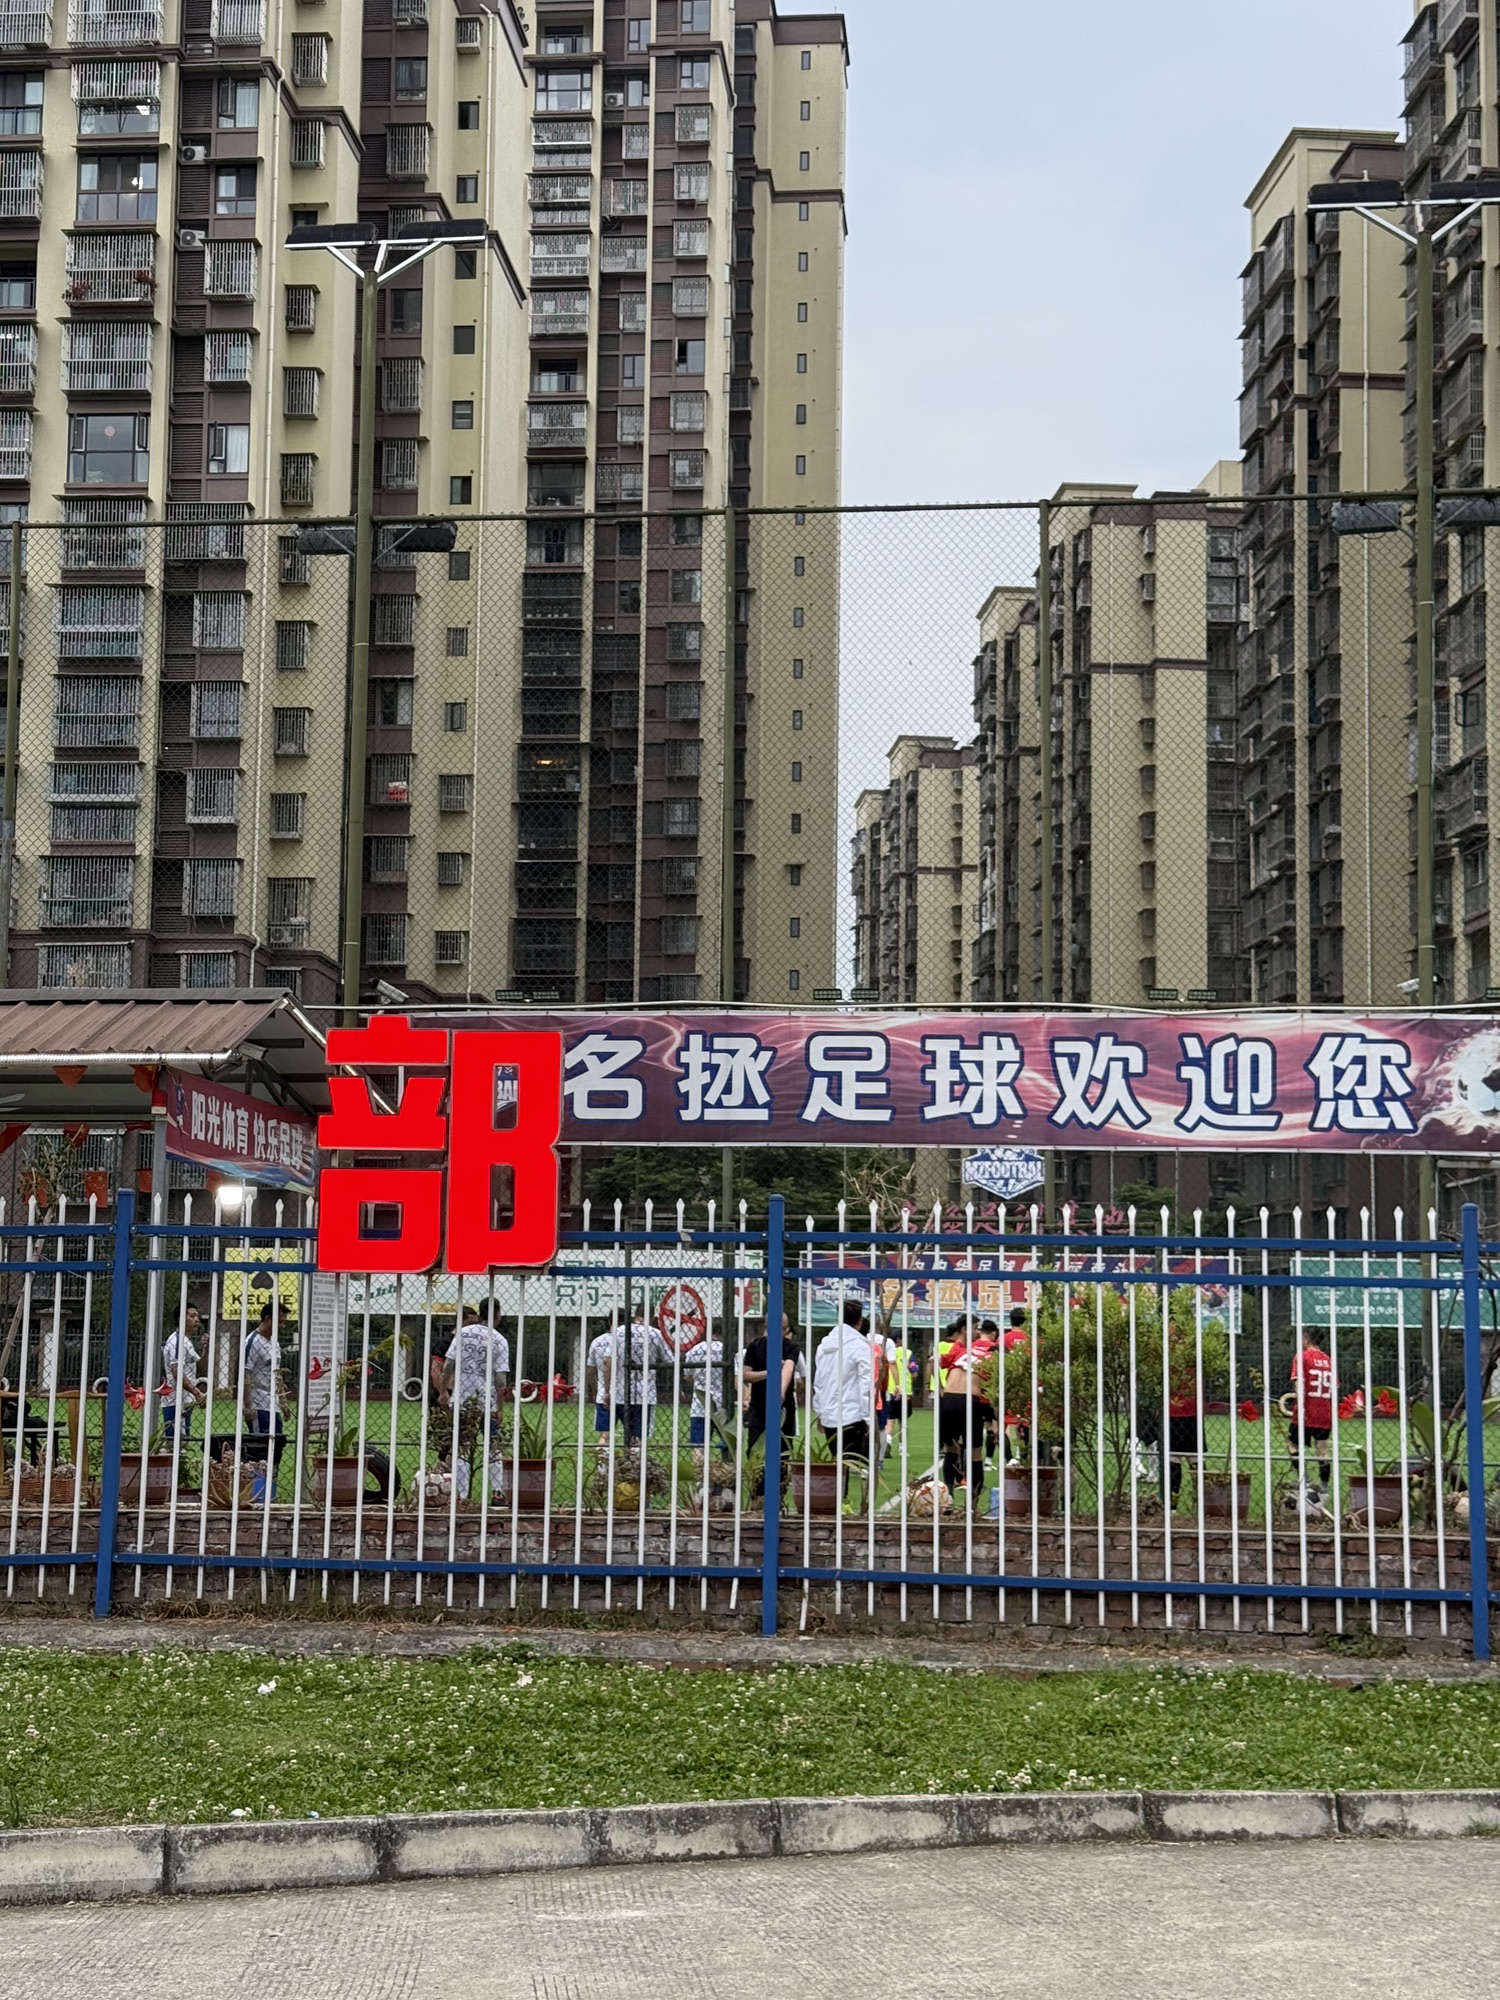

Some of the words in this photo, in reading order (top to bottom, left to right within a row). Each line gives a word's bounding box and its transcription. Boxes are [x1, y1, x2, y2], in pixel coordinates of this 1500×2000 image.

[191, 1090, 249, 1155] 阳光体育
[317, 1014, 564, 1273] 部
